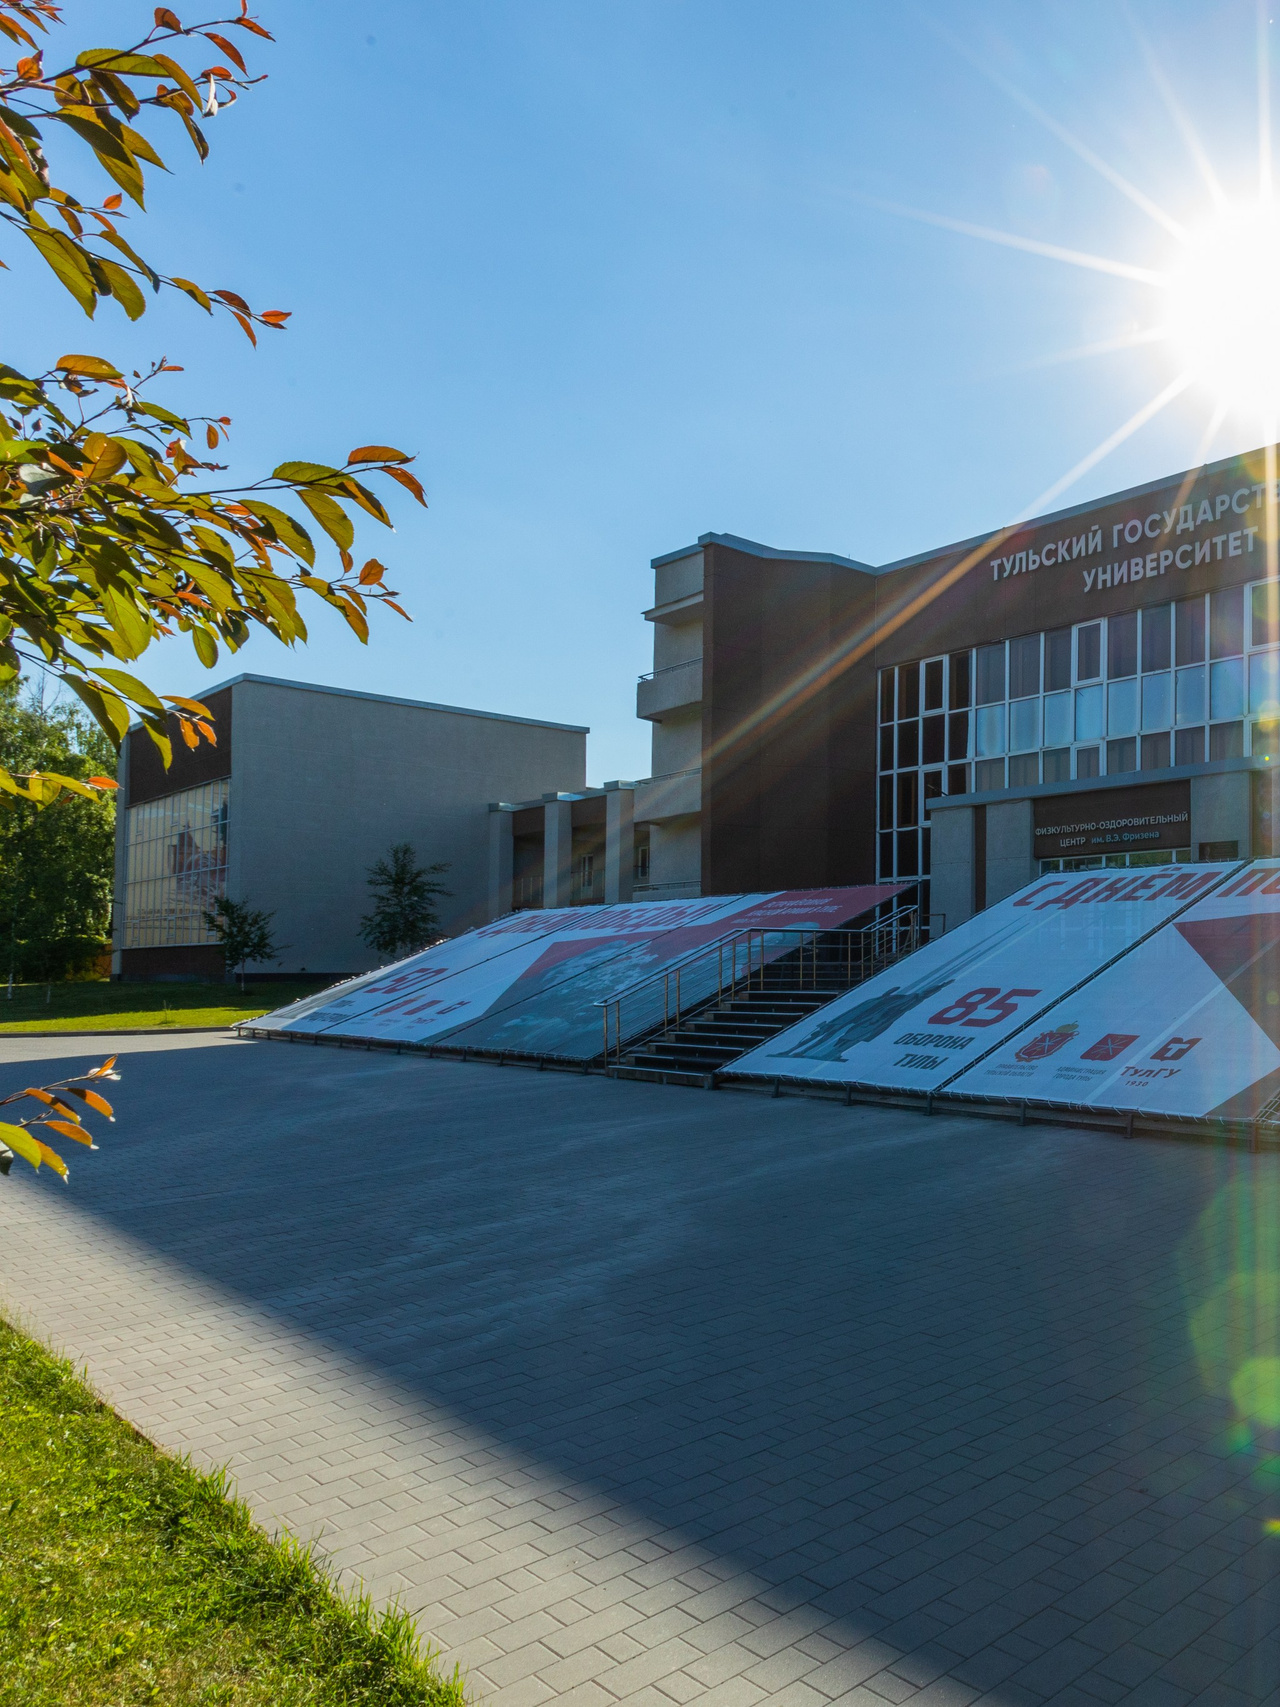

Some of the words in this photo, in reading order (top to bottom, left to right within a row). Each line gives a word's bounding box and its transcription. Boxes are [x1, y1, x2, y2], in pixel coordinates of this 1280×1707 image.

[990, 524, 1102, 581] ТУЛЬСКИЙ
[1082, 526, 1259, 593] УНИВЕРСИТЕТ
[1034, 811, 1189, 836] ФИЗКУЛЬТУРНО-ОЗДОРОВИТЕЛЬНЫЙ
[1060, 836, 1086, 848] ЦЕНТР
[1091, 836, 1105, 844] им.
[1105, 833, 1121, 843] В.Э.
[1122, 830, 1160, 843] Фризена
[1012, 880, 1068, 907] С
[1031, 867, 1225, 911] ДНЁМ
[927, 987, 1043, 1028] 85
[893, 1032, 976, 1050] ОБОРОНА
[893, 1053, 949, 1071] ТУЛЫ
[1120, 1066, 1181, 1079] ТулГУ
